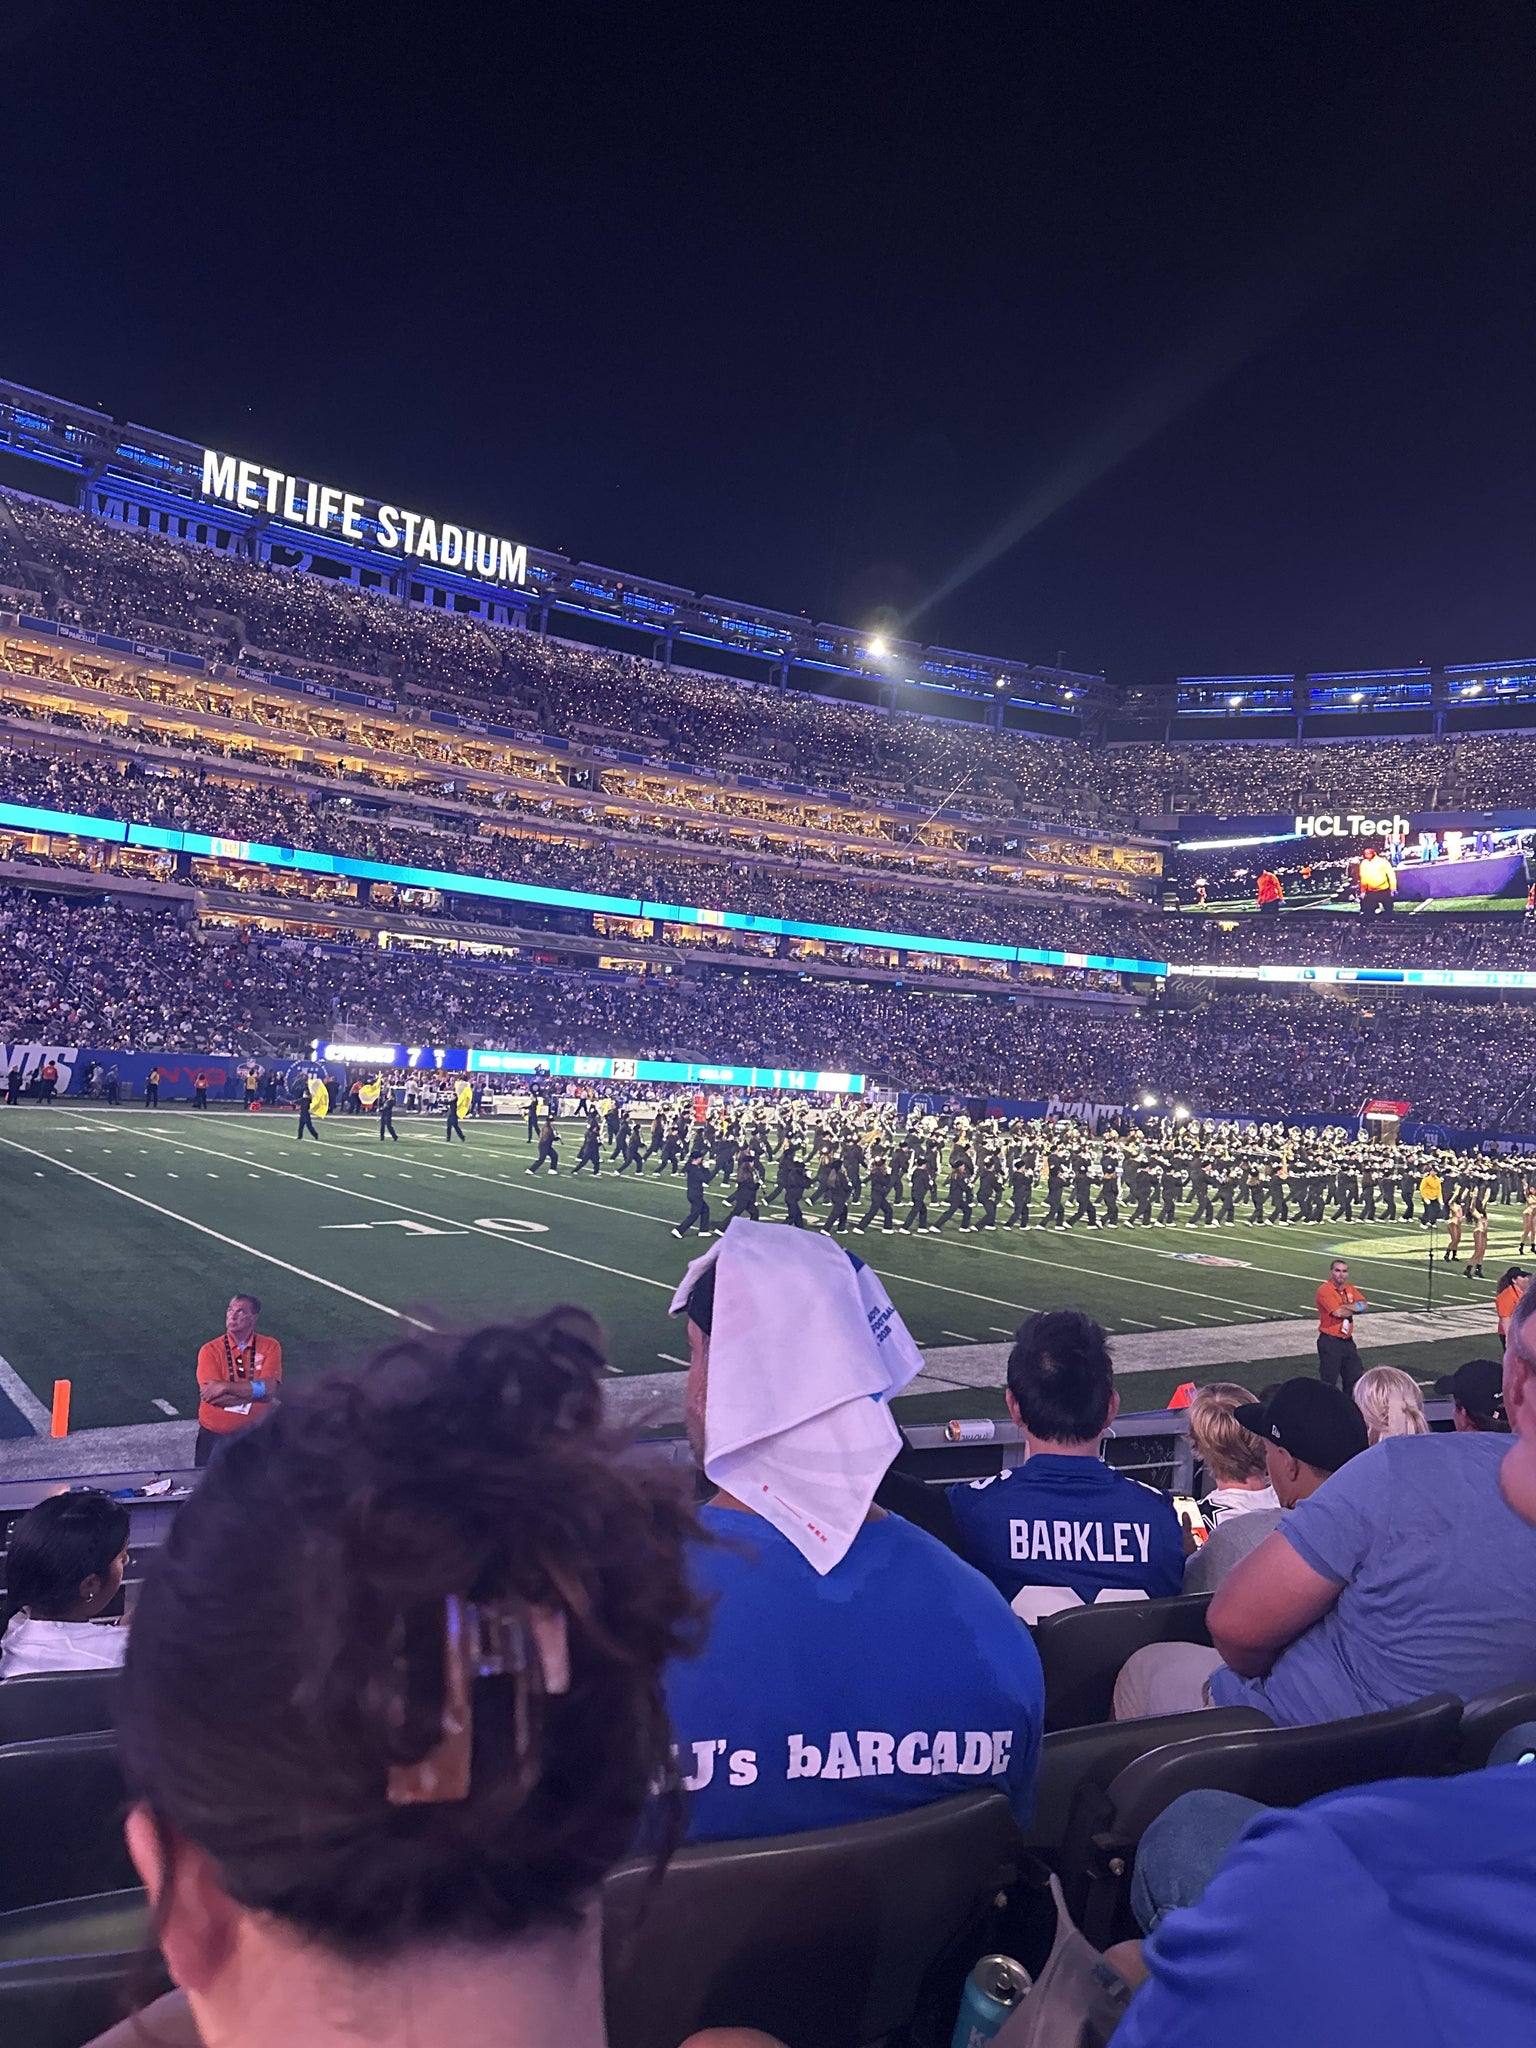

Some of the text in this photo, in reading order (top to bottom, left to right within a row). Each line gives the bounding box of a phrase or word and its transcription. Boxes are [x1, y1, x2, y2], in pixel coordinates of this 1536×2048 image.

[201, 449, 528, 587] METLIFE STADIUM
[1295, 815, 1410, 837] HCLTech
[404, 918, 522, 940] METLIFE STADIUM
[613, 1060, 635, 1077] 25
[1009, 1519, 1150, 1563] BARKLEY
[655, 1730, 1014, 1793] J's bARCADE
